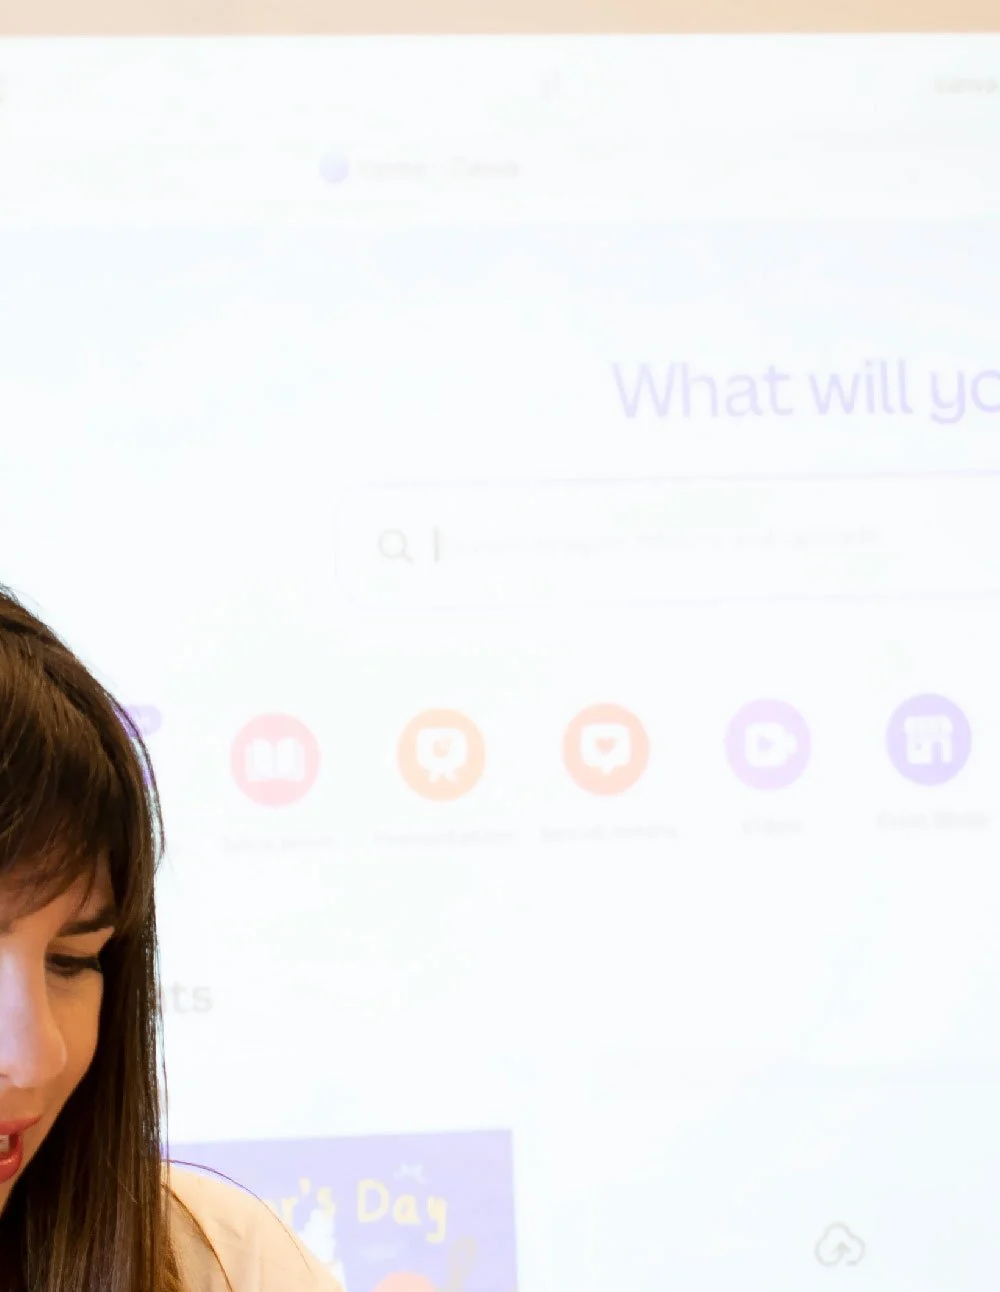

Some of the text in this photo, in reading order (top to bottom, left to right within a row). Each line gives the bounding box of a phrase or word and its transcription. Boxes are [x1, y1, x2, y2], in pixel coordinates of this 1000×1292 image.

[611, 360, 793, 419] What
[807, 359, 914, 415] will
[162, 981, 214, 1014] ts
[273, 1177, 448, 1244] r's Day
